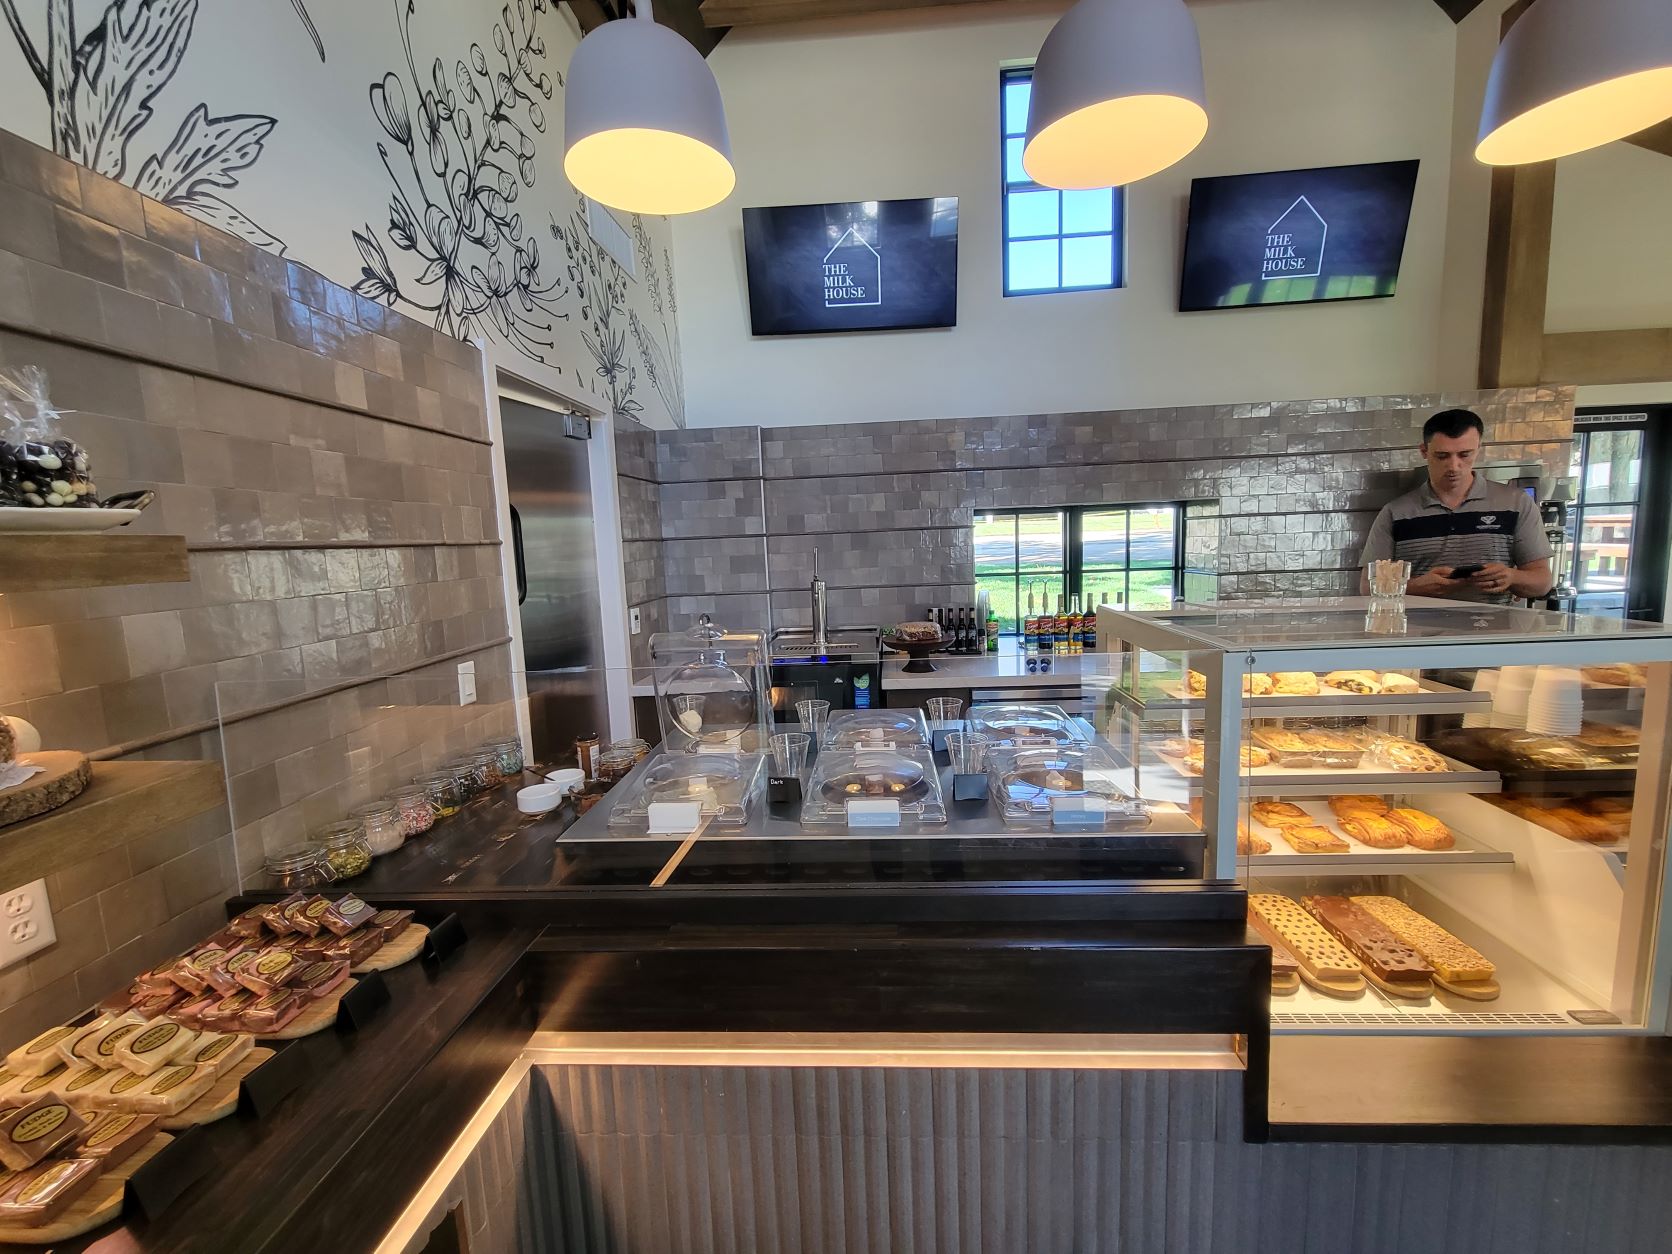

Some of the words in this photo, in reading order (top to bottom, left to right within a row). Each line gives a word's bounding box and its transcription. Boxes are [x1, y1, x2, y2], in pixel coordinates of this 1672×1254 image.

[1265, 233, 1292, 246] THE
[1263, 246, 1296, 259] MILK
[823, 263, 848, 275] THE
[1262, 258, 1306, 272] HOUSE
[824, 275, 854, 288] MILK
[824, 287, 865, 300] HOUSE
[105, 1028, 131, 1046] FUDGE
[20, 1107, 54, 1130] FUDGE
